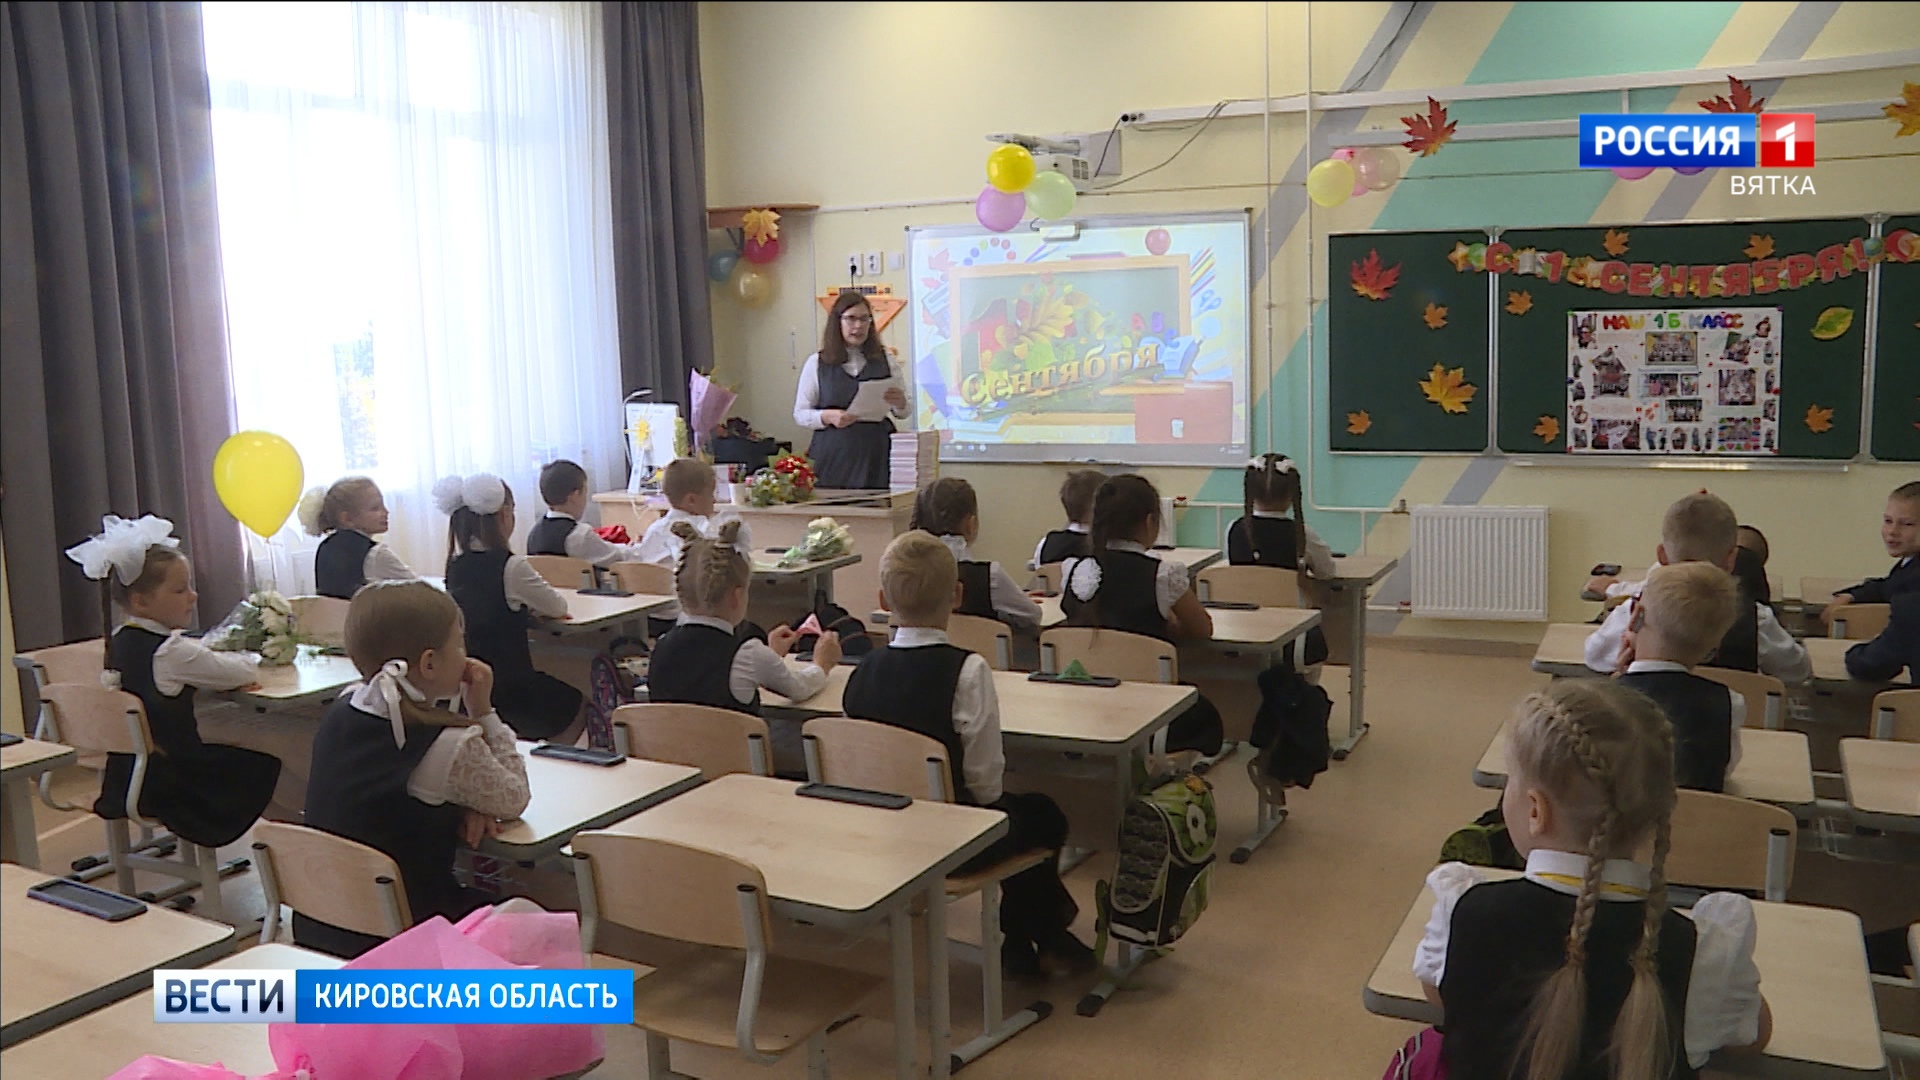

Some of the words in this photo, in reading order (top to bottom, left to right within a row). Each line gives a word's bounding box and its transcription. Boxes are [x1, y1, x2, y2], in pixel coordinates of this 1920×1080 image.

[1485, 242, 1513, 273] С
[1545, 251, 1564, 283] 1
[1600, 237, 1869, 297] СЕНТЯБРЯ!
[1603, 314, 1645, 330] НАШ
[1689, 313, 1744, 330] КЛАСС
[961, 342, 1160, 406] Сентября
